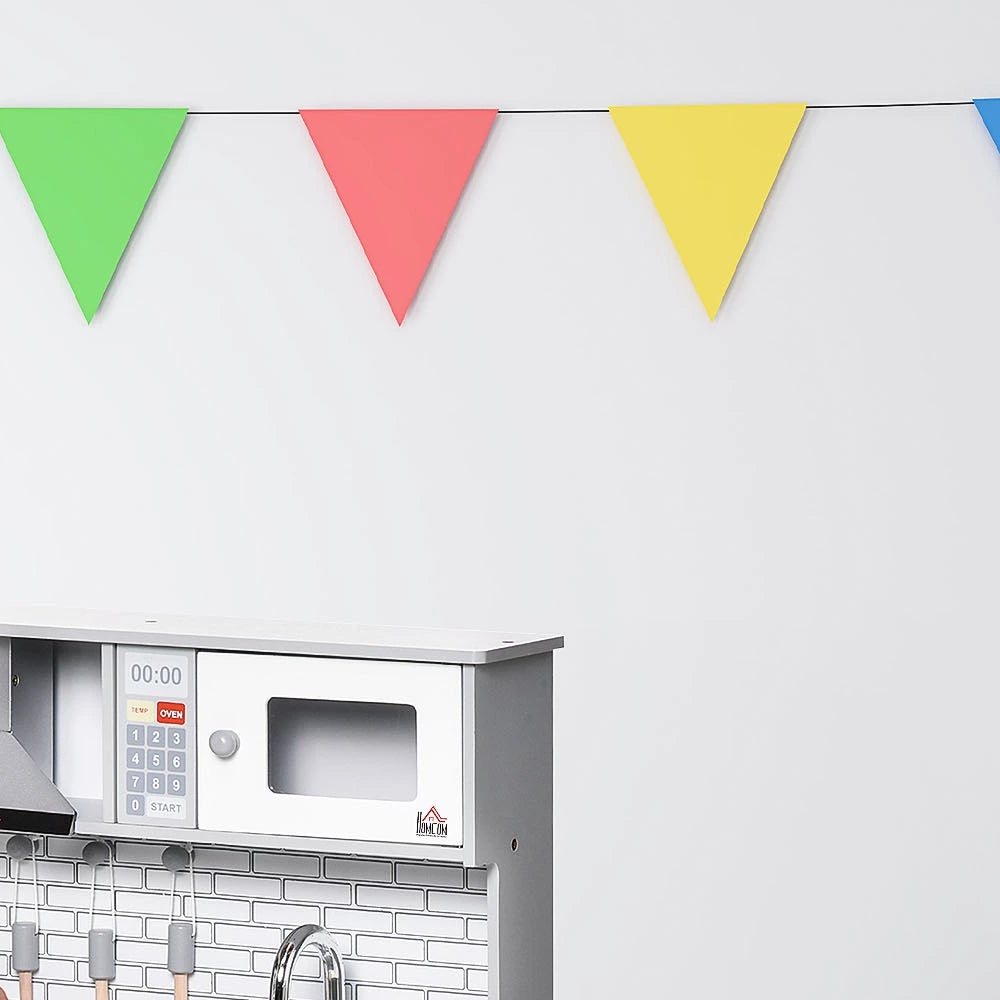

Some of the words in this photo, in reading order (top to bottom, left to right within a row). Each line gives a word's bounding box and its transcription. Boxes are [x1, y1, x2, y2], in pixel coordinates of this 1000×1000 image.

[131, 663, 182, 685] 00:00
[160, 709, 183, 719] OVEN
[132, 729, 139, 741] 1
[152, 731, 160, 743] 2
[173, 733, 180, 744] 3
[132, 753, 139, 765] 4
[153, 754, 160, 766] 5
[173, 756, 180, 768] 6
[132, 776, 139, 788] 7
[152, 778, 160, 790] 8
[173, 780, 180, 791] 9
[132, 799, 139, 811] 0
[150, 802, 182, 813] START
